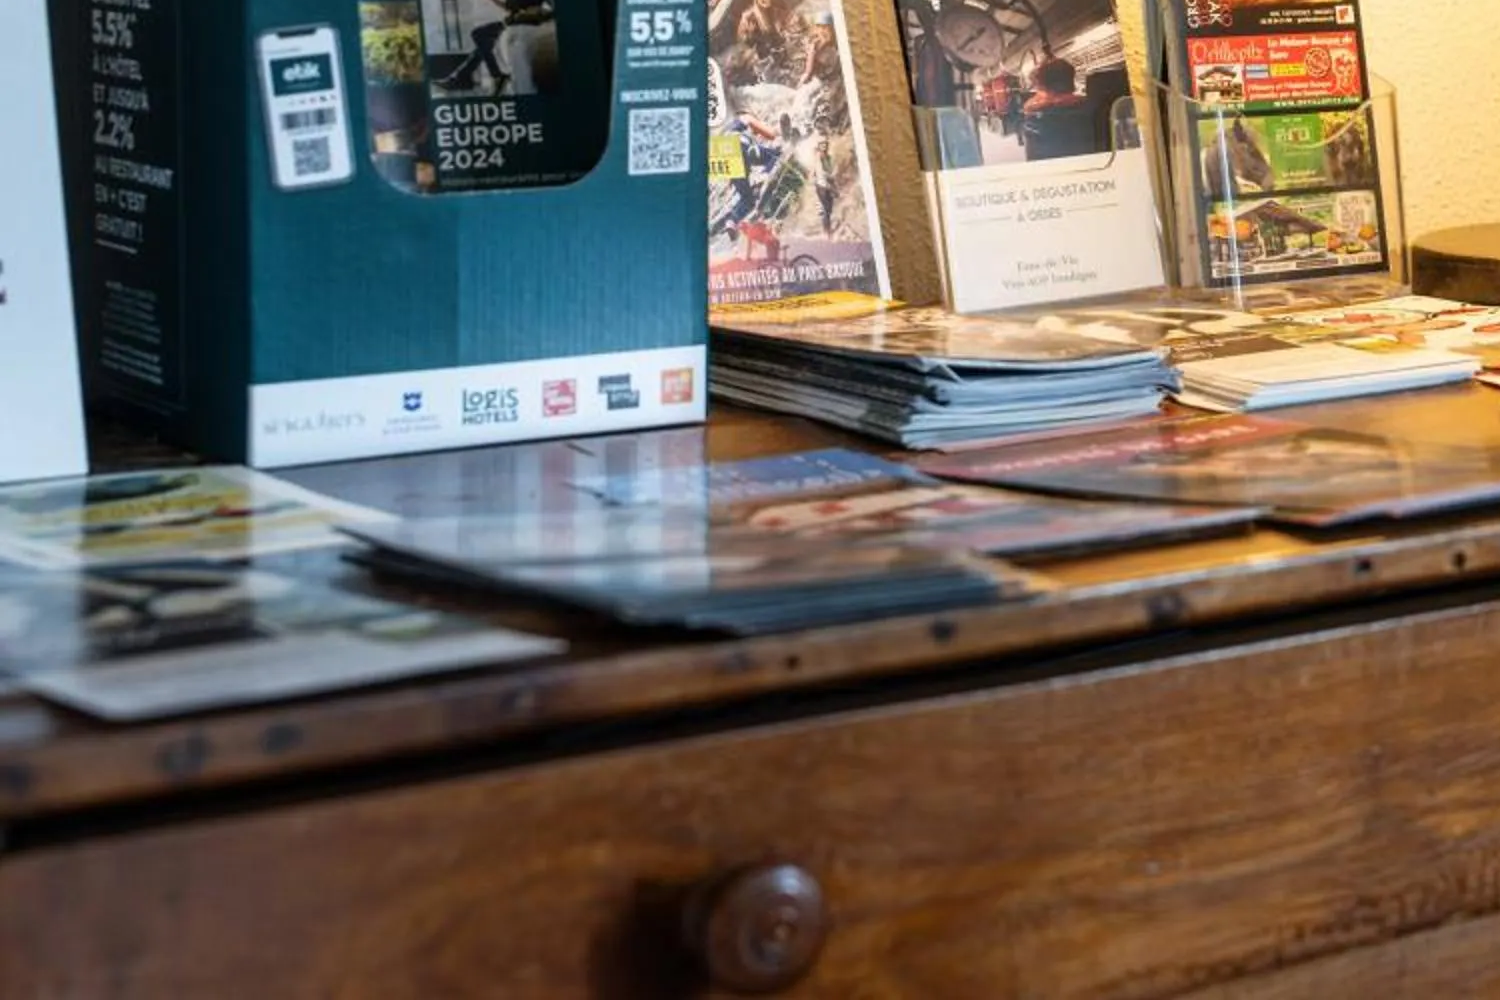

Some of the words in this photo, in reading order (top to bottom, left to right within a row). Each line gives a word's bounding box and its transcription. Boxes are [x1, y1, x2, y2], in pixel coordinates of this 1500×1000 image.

[434, 101, 517, 124] GUIDE
[436, 123, 545, 148] EUROPE
[438, 148, 506, 171] 2024
[462, 410, 520, 426] HOTELS
